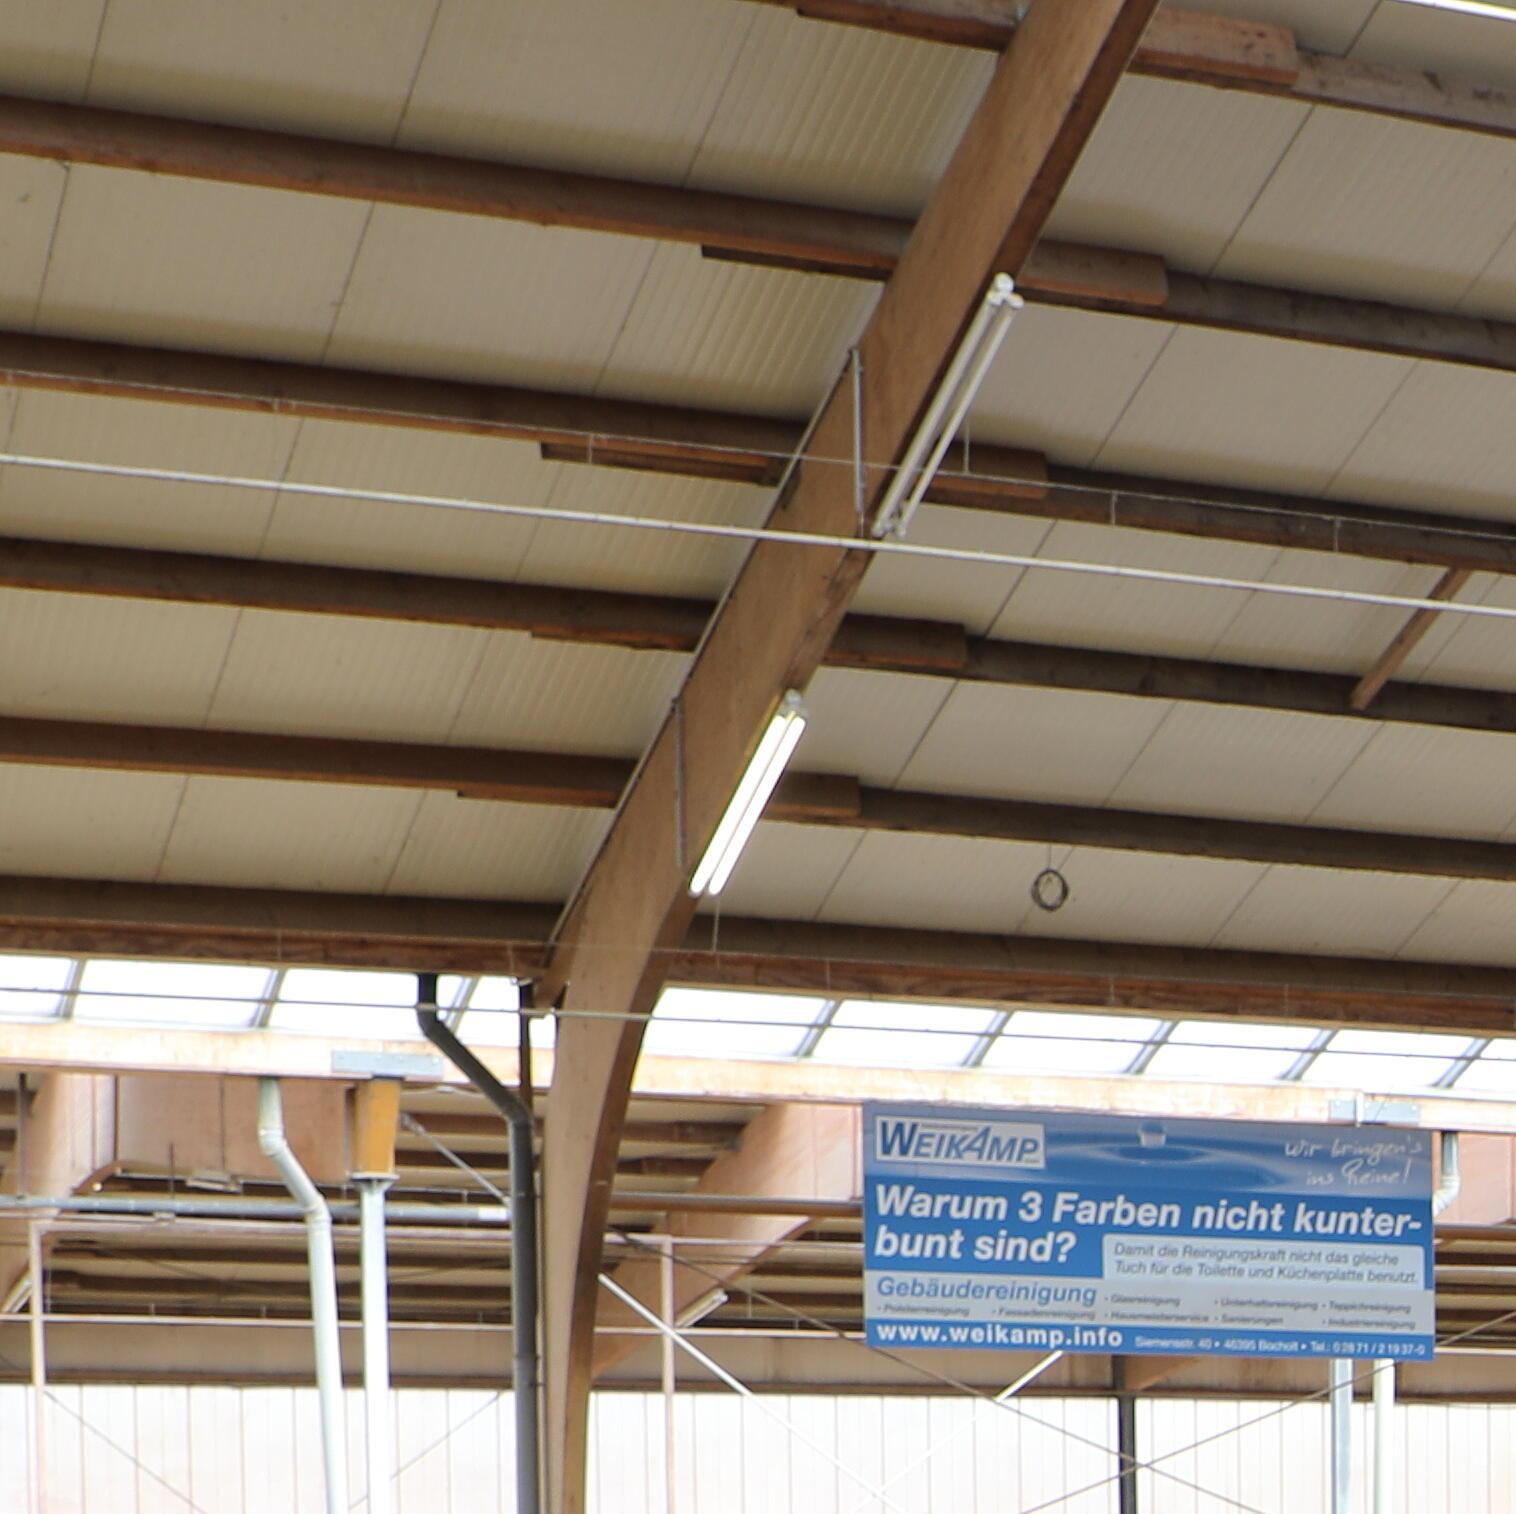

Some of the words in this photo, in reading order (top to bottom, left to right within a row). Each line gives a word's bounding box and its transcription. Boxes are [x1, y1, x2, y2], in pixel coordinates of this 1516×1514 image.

[881, 1120, 1040, 1162] WEIKAMP
[875, 1184, 1008, 1221] Warum
[1018, 1190, 1042, 1222] 3
[1052, 1192, 1181, 1228] Farben
[1192, 1199, 1284, 1232] nicht
[1293, 1203, 1422, 1237] kunter-
[874, 1224, 964, 1259] bunt
[974, 1229, 1077, 1263] sind?
[1114, 1242, 1155, 1257] Damit
[1158, 1244, 1178, 1258] die
[1183, 1244, 1286, 1263] Reinigungskraft
[1290, 1250, 1322, 1263] nicht
[1326, 1252, 1349, 1264] das
[1353, 1253, 1399, 1268] gleiche
[1115, 1260, 1146, 1274] Tuch
[1150, 1261, 1169, 1275] für
[1172, 1263, 1193, 1276] die
[1198, 1263, 1245, 1278] Toilette
[1249, 1265, 1274, 1278] und
[1277, 1266, 1364, 1283] Küchenplatte
[877, 1275, 1097, 1307] Gebäudereinigung
[876, 1323, 1123, 1349] www.weikamp.info
[1258, 1338, 1298, 1352] Bocholt
